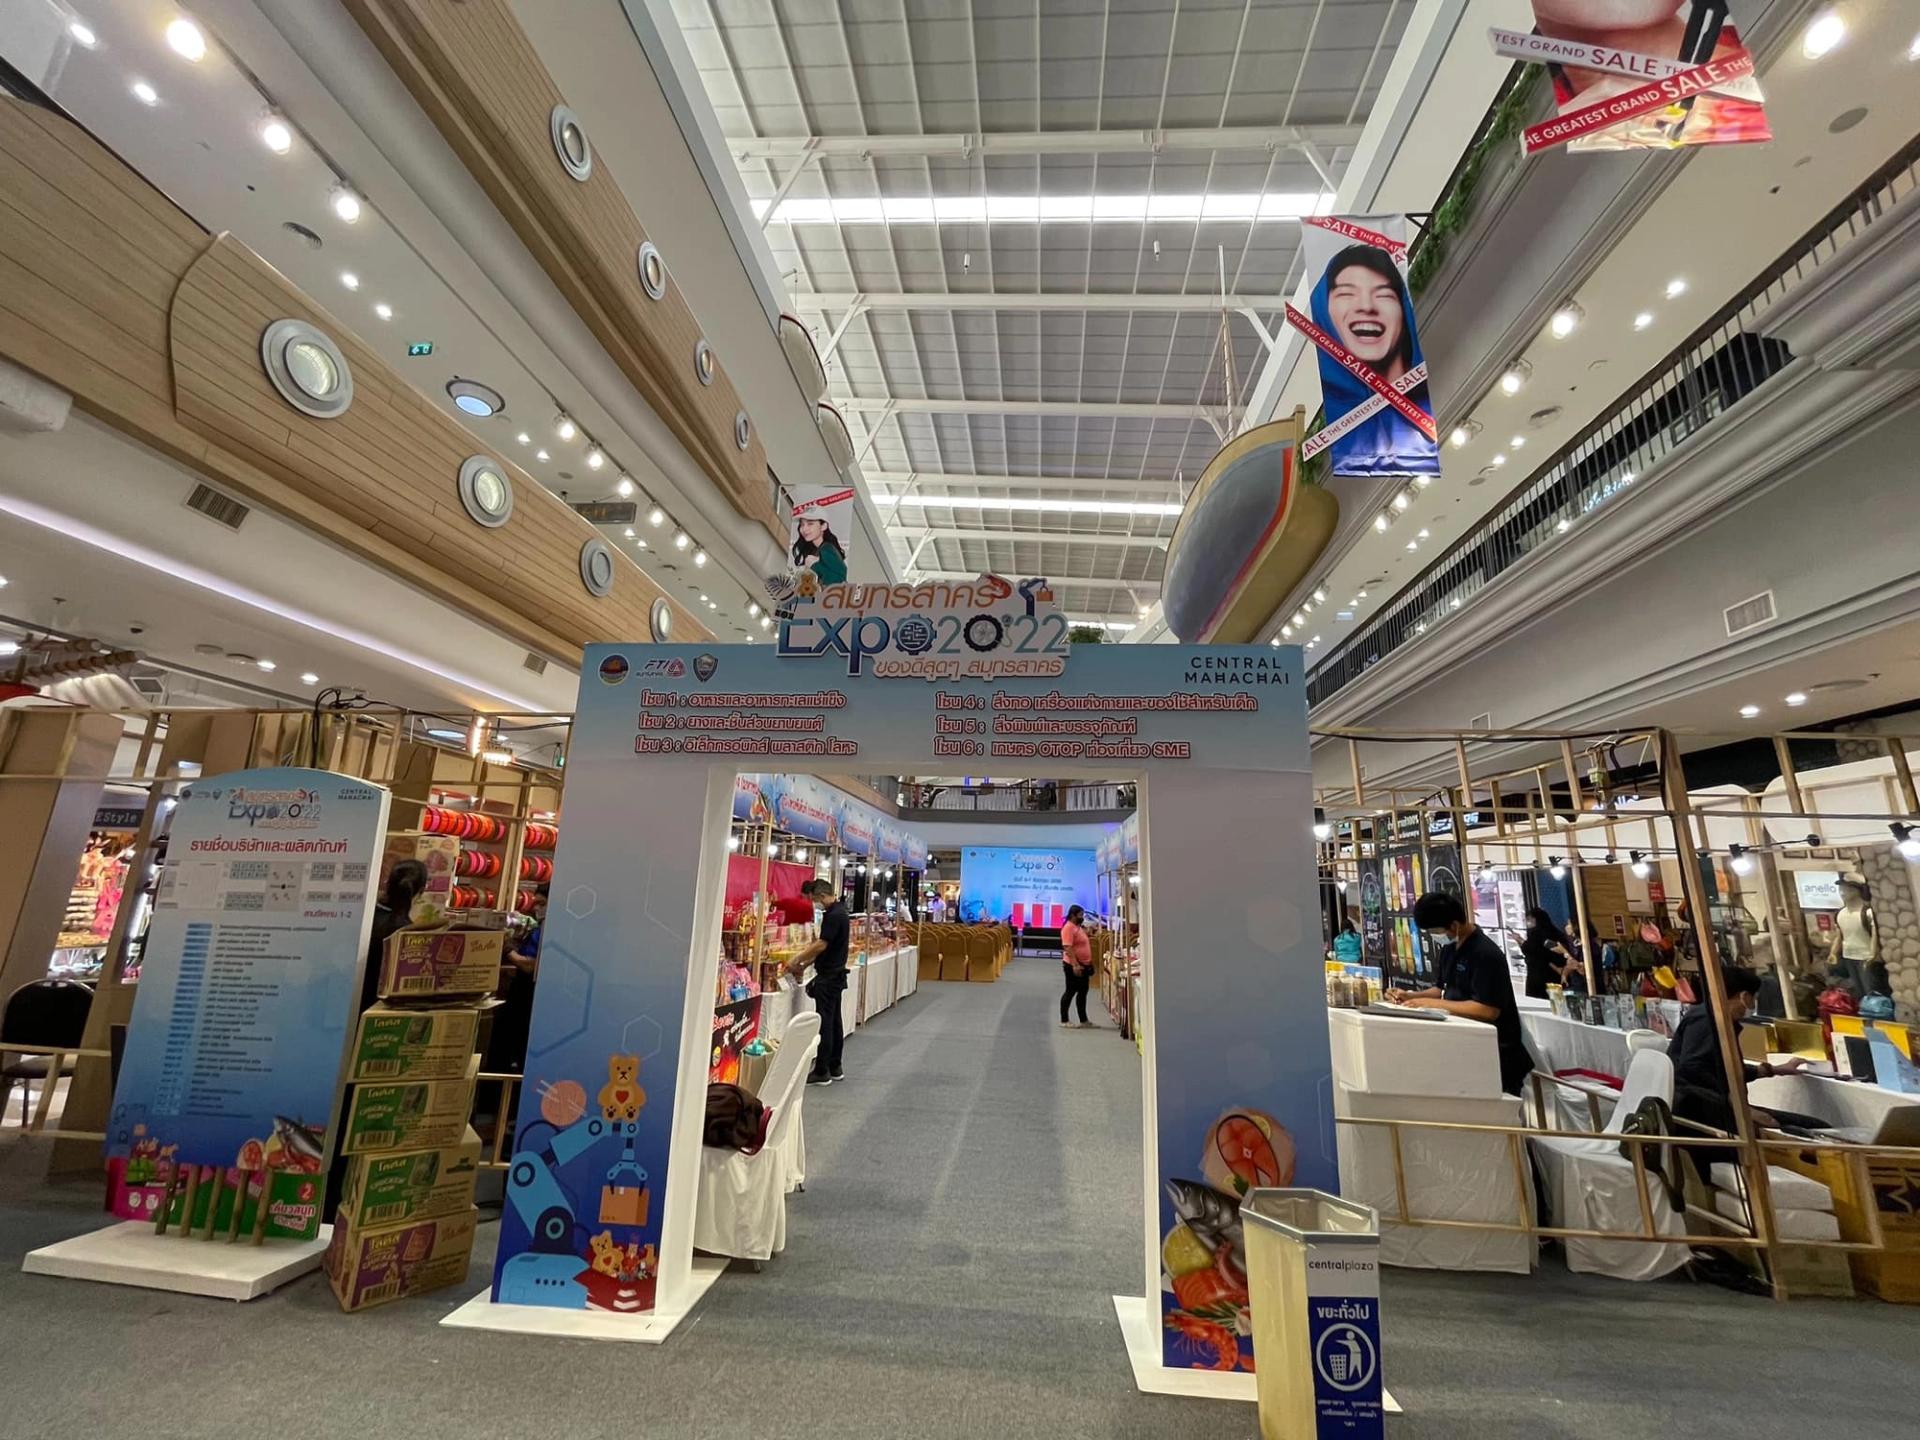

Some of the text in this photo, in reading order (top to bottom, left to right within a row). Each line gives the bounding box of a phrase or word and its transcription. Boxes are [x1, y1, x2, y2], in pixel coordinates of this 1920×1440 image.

[1494, 33, 1527, 47] TEST
[1529, 40, 1585, 58] GRAND
[1590, 49, 1657, 75] SALE
[1543, 108, 1609, 139] GREATEST
[1610, 91, 1660, 115] GRAND
[1660, 64, 1724, 99] SALE
[1724, 55, 1753, 74] THE
[1323, 218, 1358, 237] SALE
[1360, 232, 1374, 242] THE
[1288, 311, 1320, 338] GREATEST
[1320, 336, 1344, 357] GRAND
[1343, 355, 1376, 383] SALE
[1375, 380, 1388, 393] THE
[1388, 391, 1421, 420] GREATEST
[1304, 432, 1329, 457] ALE
[1328, 426, 1341, 437] THE
[1341, 404, 1372, 426] GREATEST
[1395, 367, 1427, 391] SALE
[821, 582, 1000, 615] สมุทรสาคร
[876, 657, 1063, 679] ของดีสุดๆ สมุทรสาคร
[1191, 657, 1281, 669] CENTRAL
[1185, 672, 1289, 685] MAHACHAI
[641, 689, 666, 707] โซน
[936, 691, 963, 710] โซน
[639, 711, 664, 729] โซน
[936, 714, 963, 734] โซน
[993, 714, 1138, 738] สิ่งพิมพ์และบรรจุภัณฑ์
[635, 734, 660, 753] โซน
[771, 738, 825, 754] พลาสติก
[827, 737, 858, 755] โลหะ
[934, 736, 961, 755] โซน
[992, 741, 1036, 757] เกษตร
[1038, 741, 1083, 757] OTOP
[1152, 742, 1191, 758] SME
[190, 834, 348, 853] รายชื่อบริษัทและผลิตภัณฑ์
[1804, 884, 1836, 893] anello
[1309, 1260, 1374, 1272] centralplaza
[1317, 1299, 1369, 1319] ขยะทั่วไป
